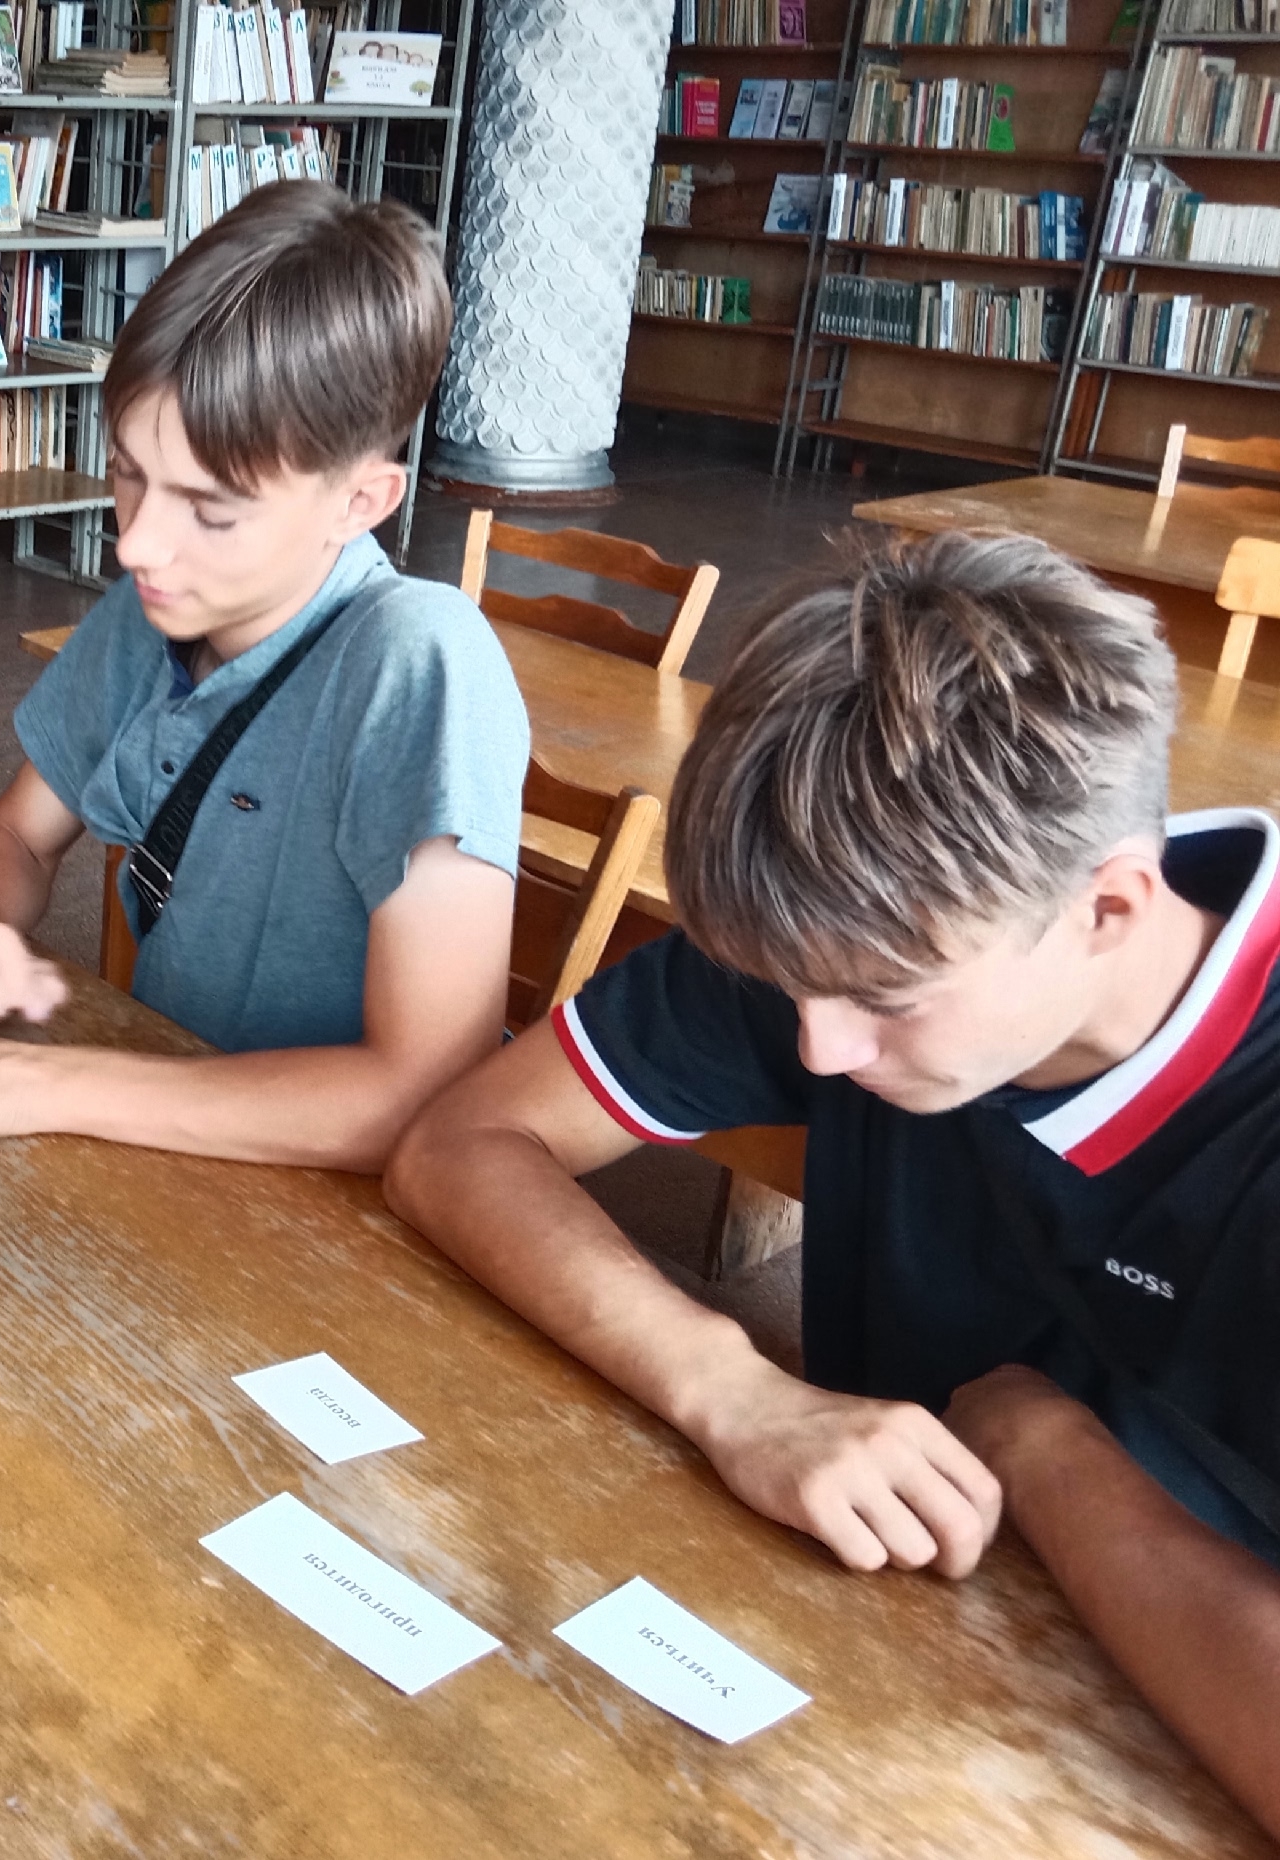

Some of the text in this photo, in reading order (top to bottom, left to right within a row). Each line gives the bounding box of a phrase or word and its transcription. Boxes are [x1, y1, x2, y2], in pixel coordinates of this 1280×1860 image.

[1104, 1257, 1176, 1301] BOSS
[305, 1386, 362, 1429] всегда
[302, 1553, 424, 1638] пригодится
[637, 1625, 737, 1700] Учиться
